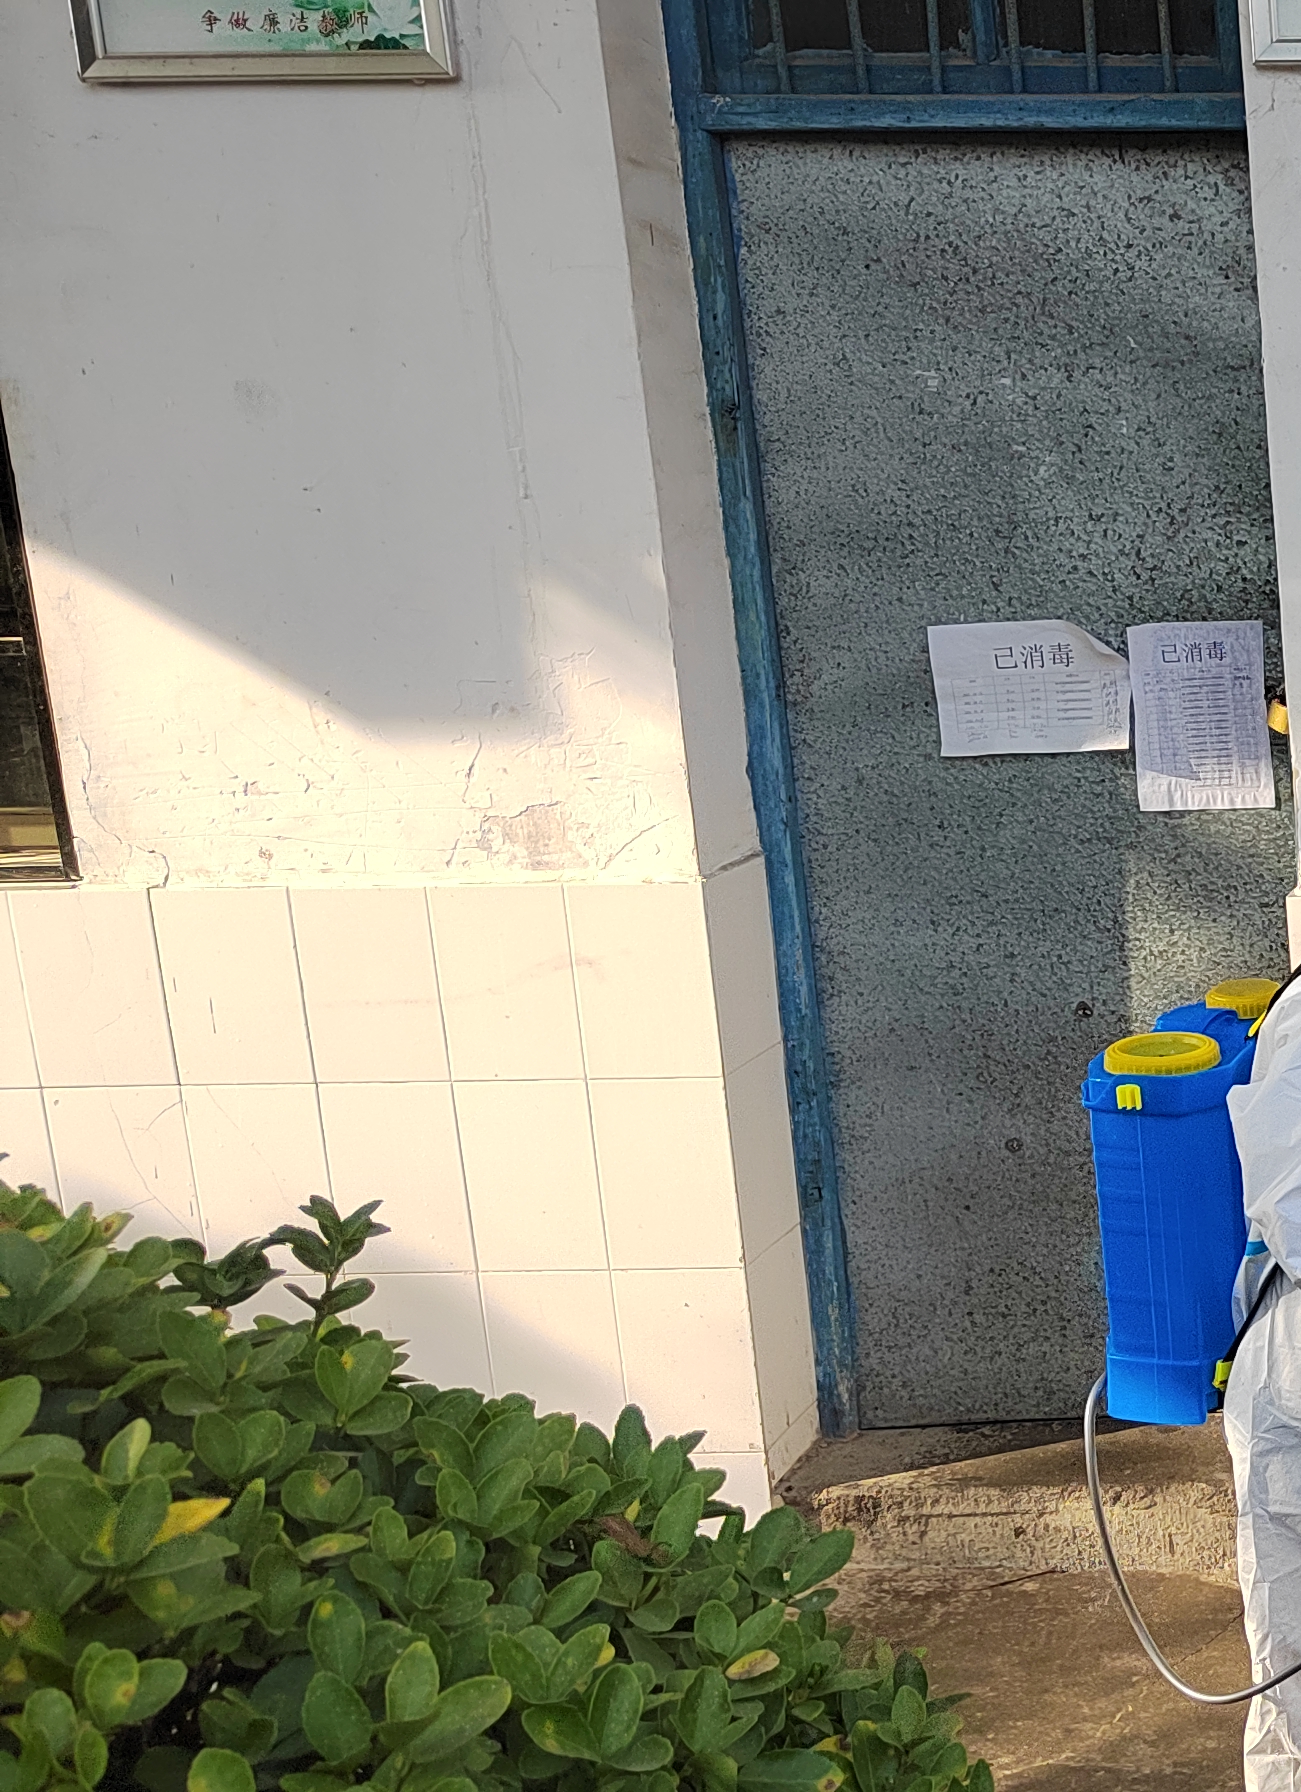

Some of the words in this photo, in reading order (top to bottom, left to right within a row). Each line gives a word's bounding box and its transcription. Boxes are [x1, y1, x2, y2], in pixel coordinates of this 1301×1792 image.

[200, 9, 369, 34] 争做廉洁教师
[993, 642, 1075, 670] 已消毒
[1160, 640, 1227, 663] 已消毒
